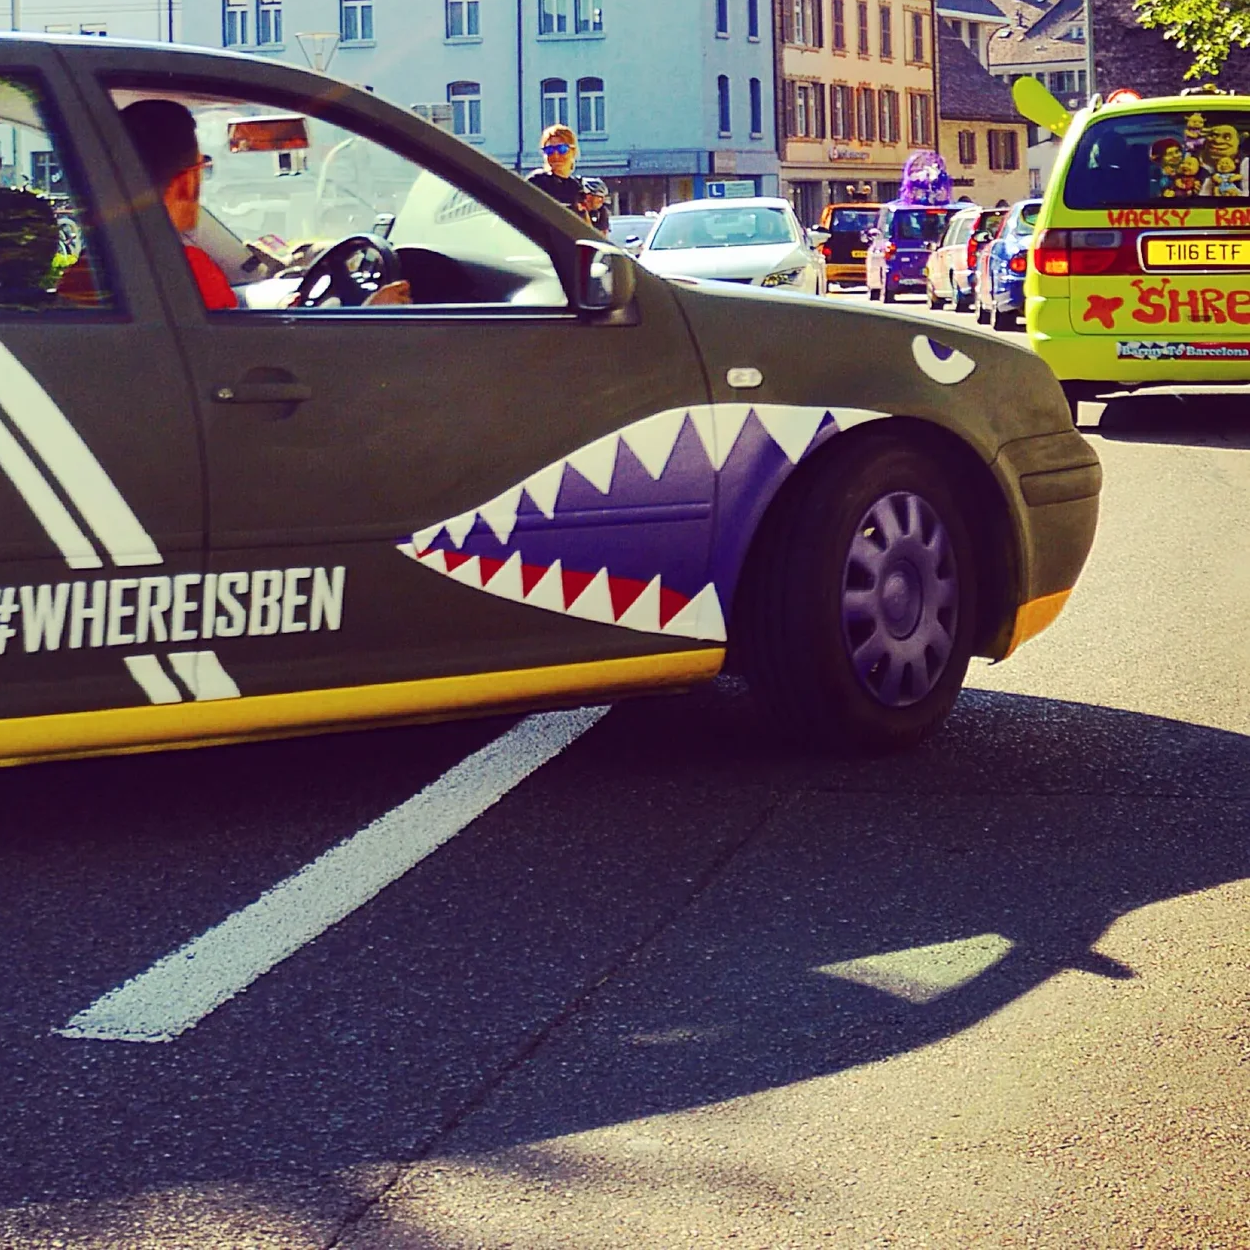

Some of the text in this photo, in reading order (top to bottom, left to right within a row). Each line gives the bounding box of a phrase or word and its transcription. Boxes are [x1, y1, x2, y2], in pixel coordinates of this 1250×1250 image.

[1107, 208, 1191, 226] WACKY
[1166, 244, 1242, 260] T116 ETF
[1186, 346, 1249, 356] Barcelona
